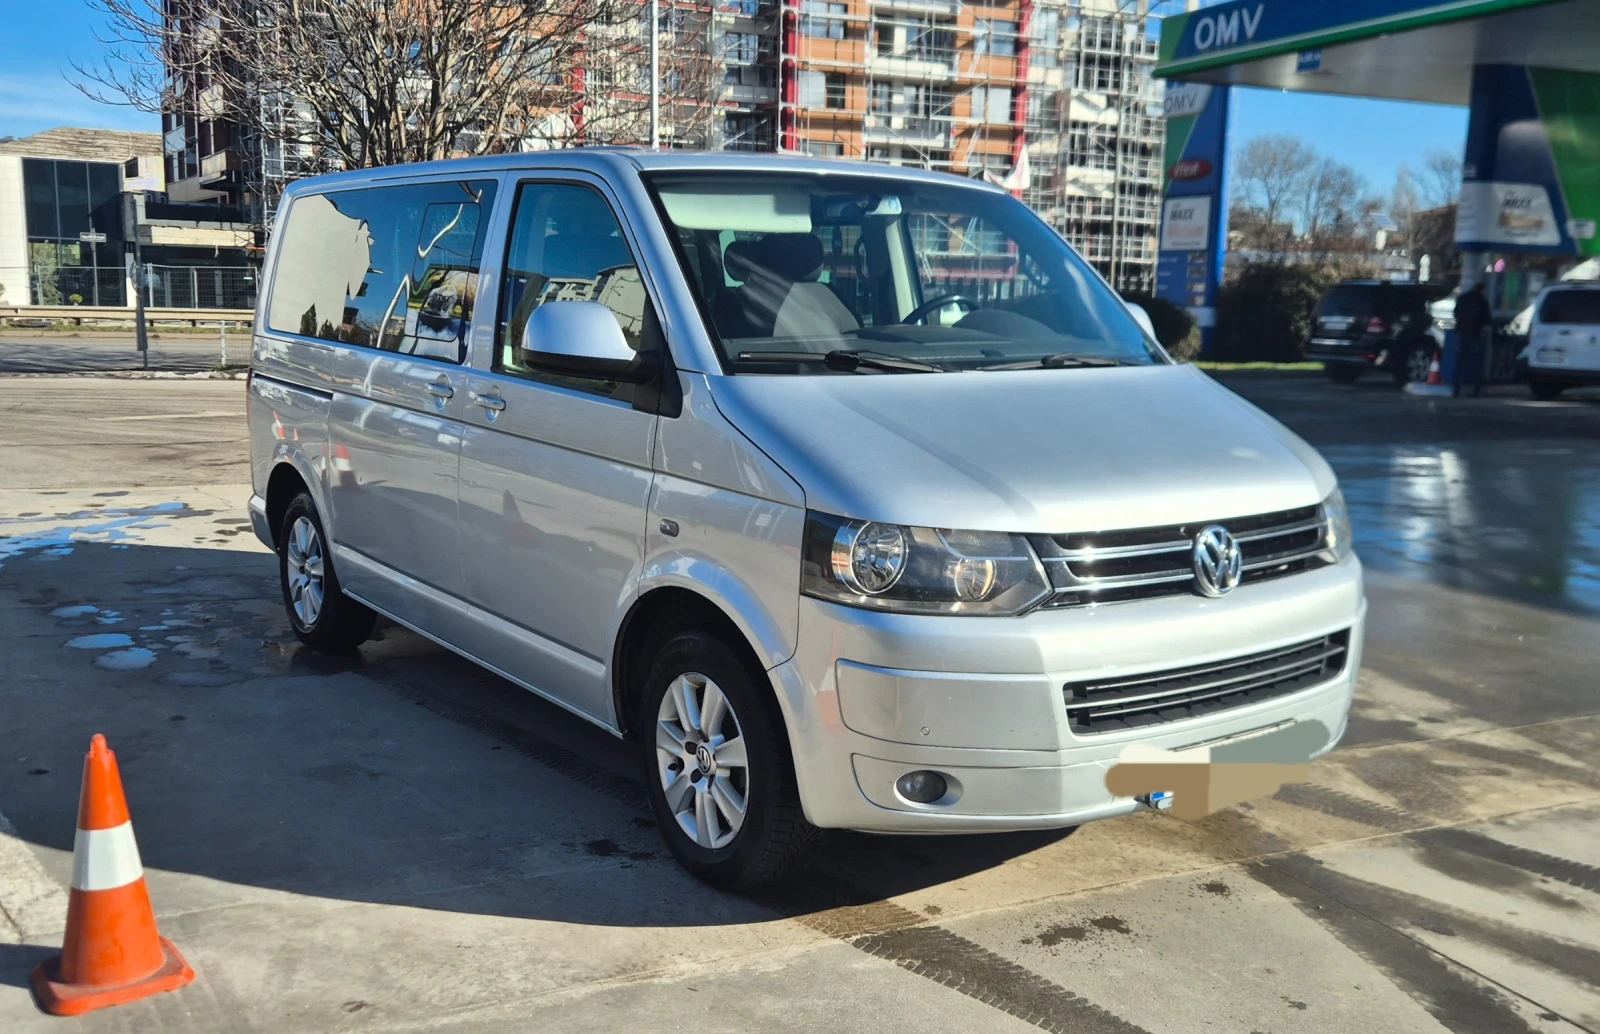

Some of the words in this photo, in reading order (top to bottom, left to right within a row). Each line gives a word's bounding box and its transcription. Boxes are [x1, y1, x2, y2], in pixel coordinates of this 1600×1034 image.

[1194, 3, 1265, 50] OMV
[1164, 92, 1198, 113] OMV
[1170, 208, 1195, 220] MAXX
